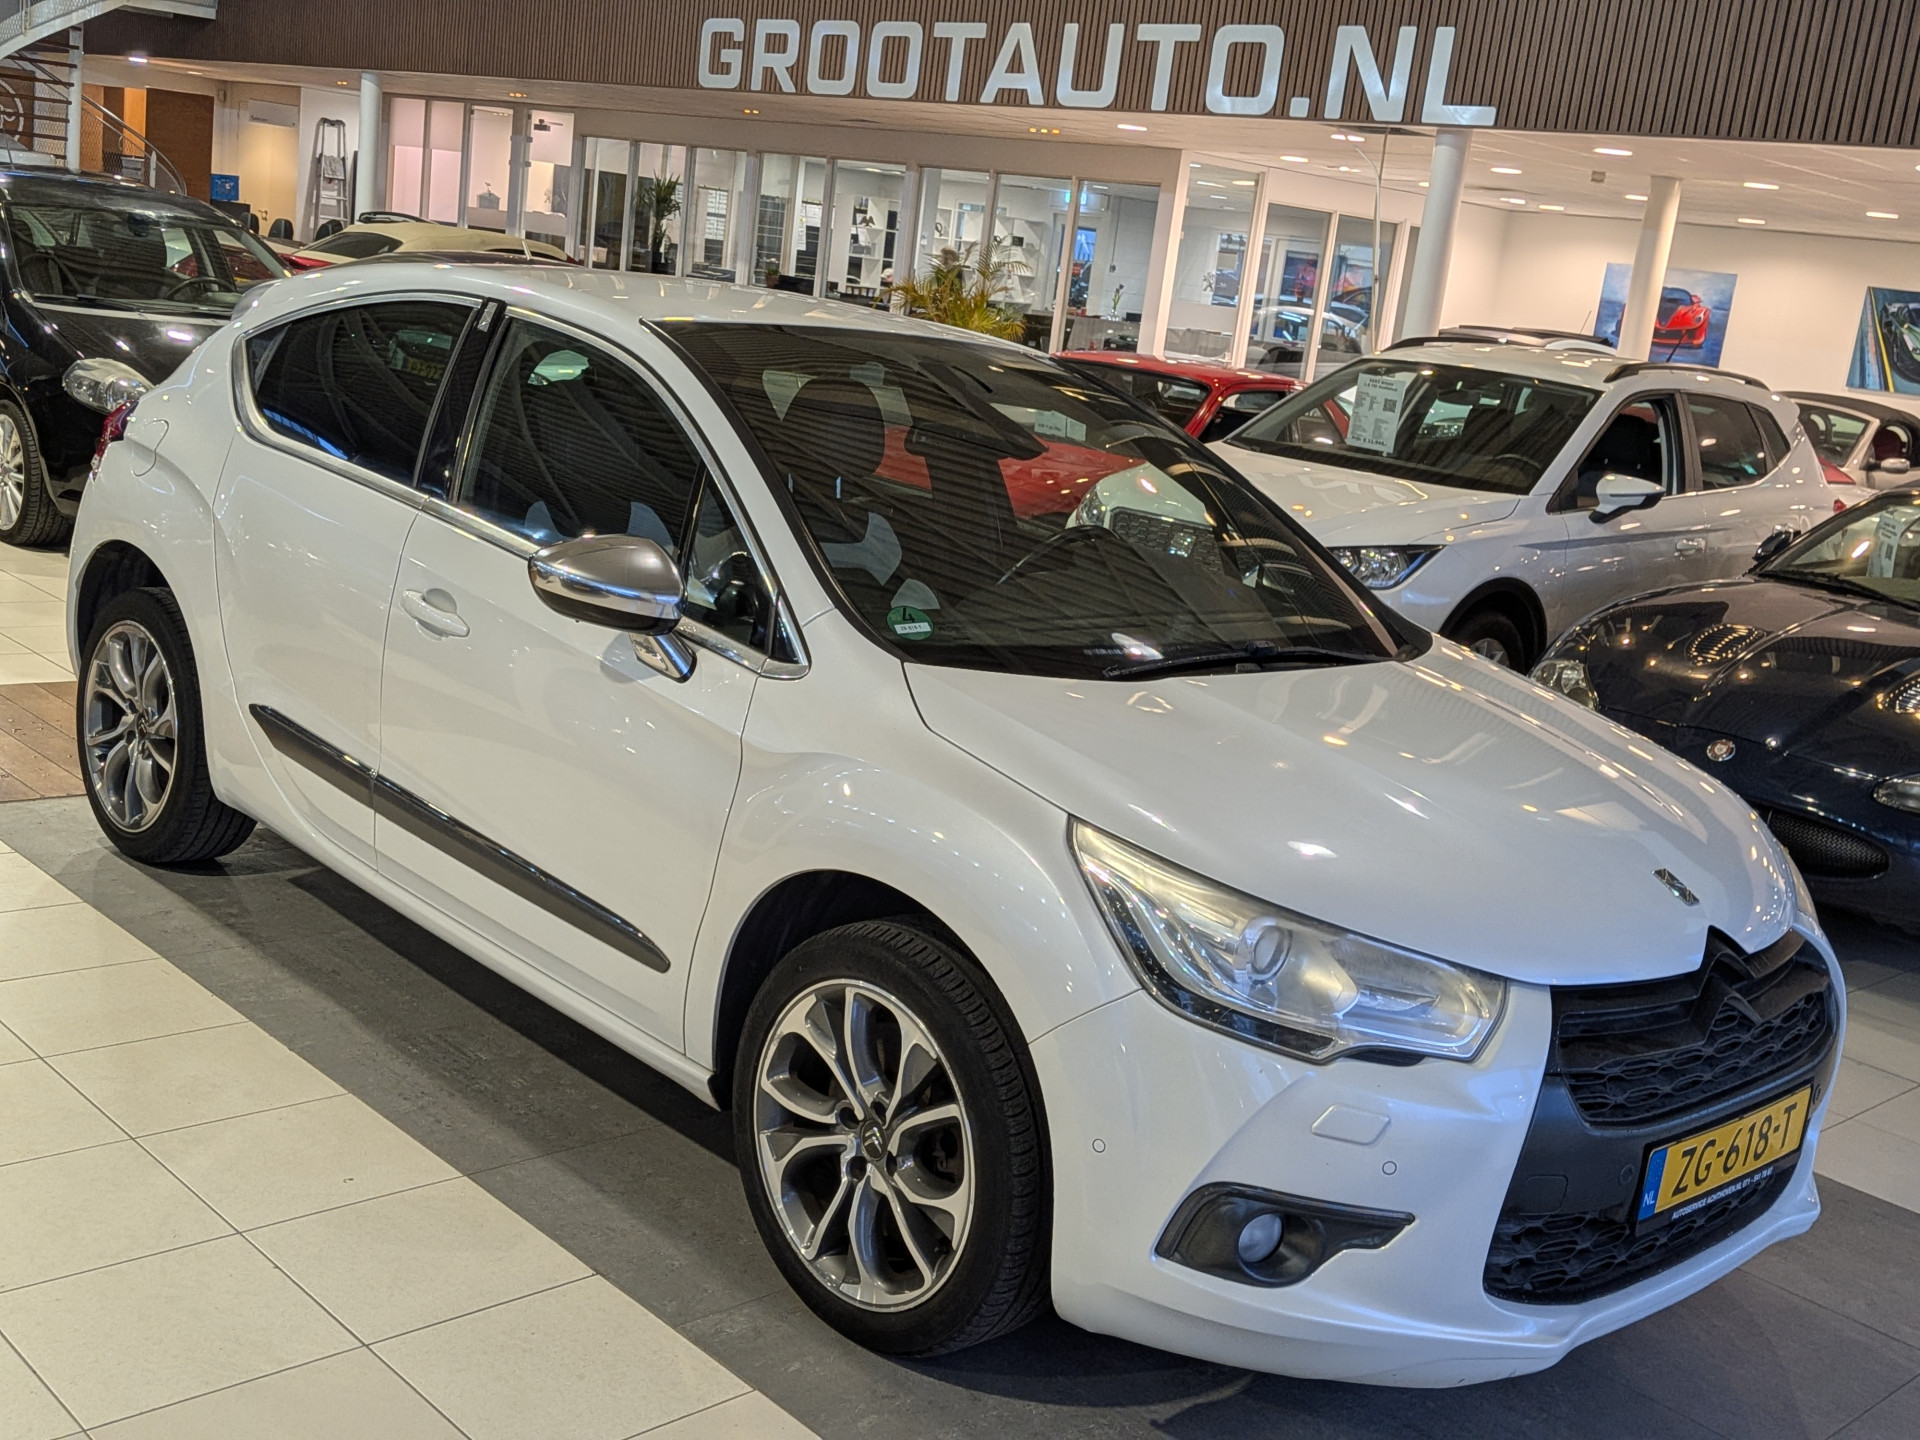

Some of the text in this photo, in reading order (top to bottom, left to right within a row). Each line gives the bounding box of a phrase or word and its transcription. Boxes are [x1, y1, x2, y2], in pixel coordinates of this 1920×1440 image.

[697, 17, 1498, 128] GROOTAUTO.NL
[1671, 1101, 1798, 1198] ZG-618-T
[1642, 1190, 1655, 1208] NL
[1671, 1197, 1707, 1220] AUTOSERVICE
[1706, 1183, 1742, 1205] ACHTHOVEN.NL
